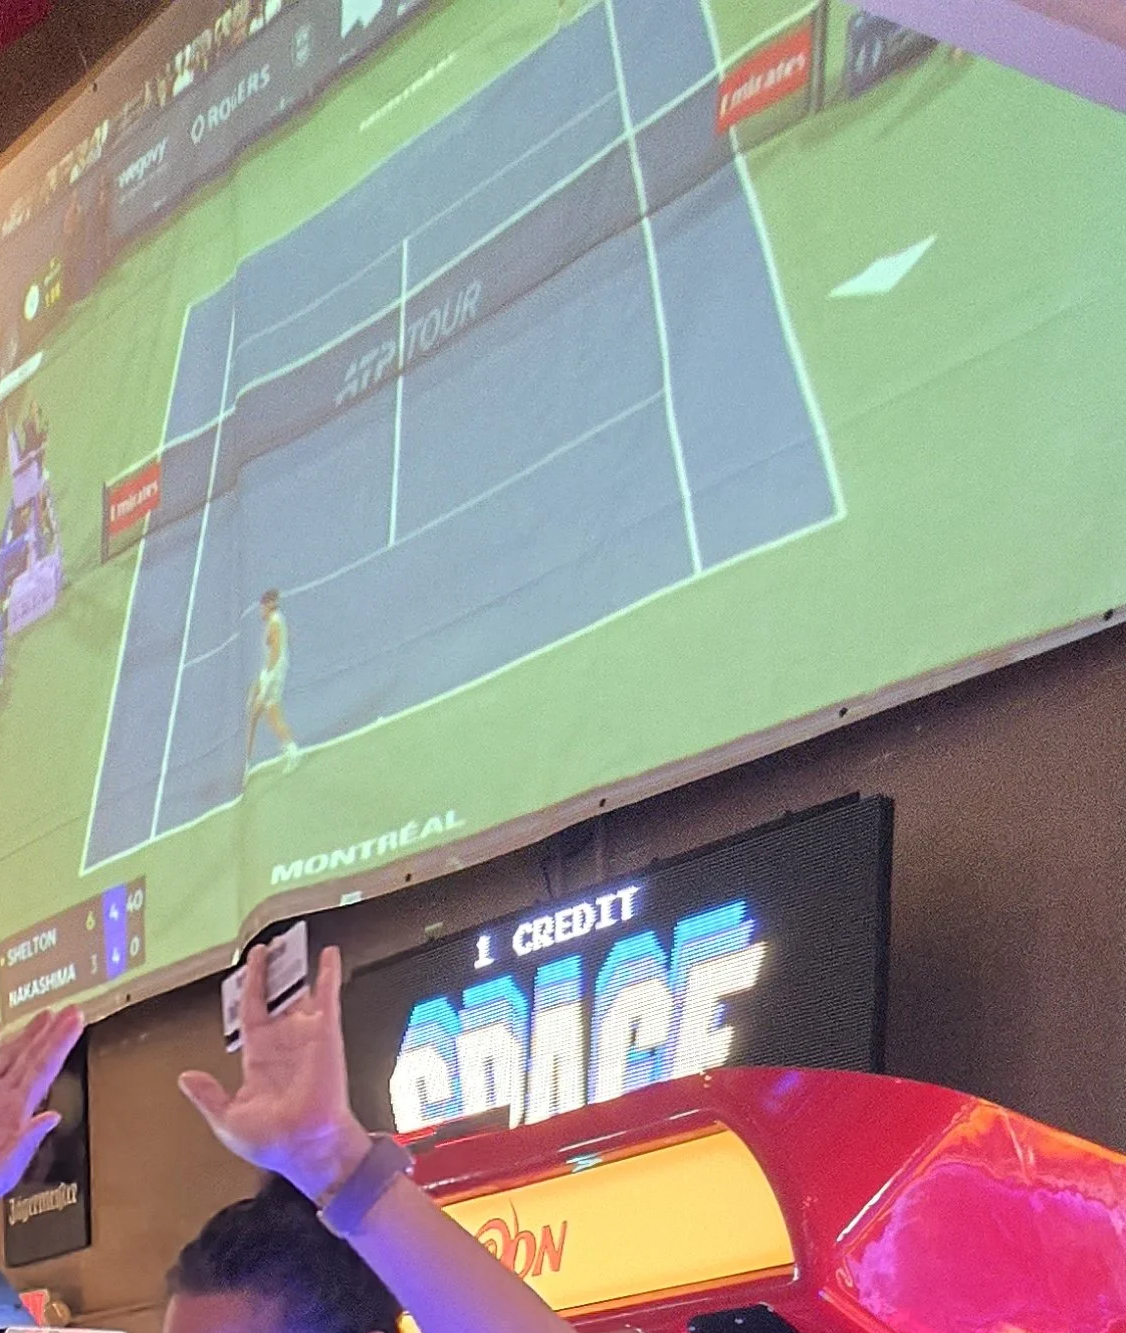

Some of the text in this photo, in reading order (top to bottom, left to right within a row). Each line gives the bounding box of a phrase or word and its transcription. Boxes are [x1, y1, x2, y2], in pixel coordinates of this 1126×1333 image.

[407, 279, 483, 361] TOUR
[270, 808, 466, 885] MONTRÉAL
[7, 928, 57, 967] SHELTON
[85, 910, 96, 931] 6
[108, 903, 119, 921] 4
[474, 885, 642, 970] 1 CREDIT
[9, 962, 76, 1008] NAKASHIMA
[129, 935, 140, 957] 0
